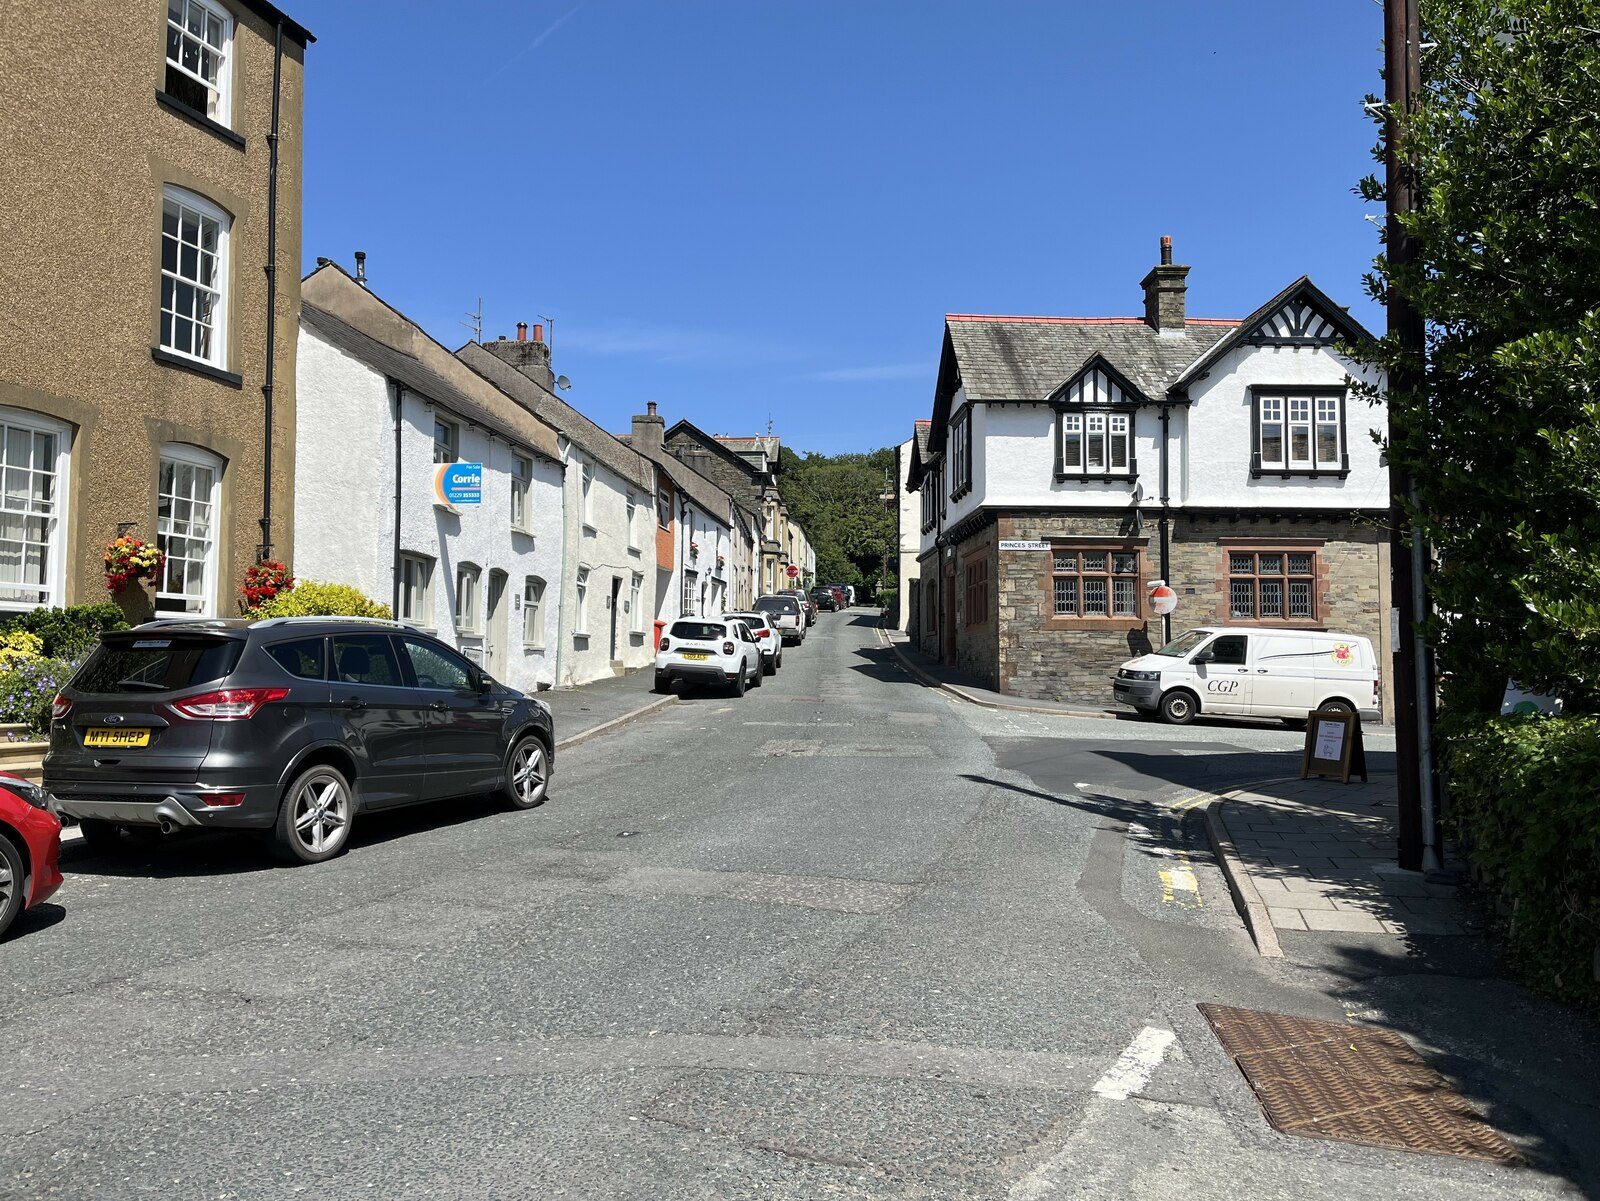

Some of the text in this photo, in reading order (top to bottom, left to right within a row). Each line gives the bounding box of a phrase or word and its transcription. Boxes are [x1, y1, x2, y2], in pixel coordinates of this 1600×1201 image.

[452, 473, 480, 483] Corrie
[1207, 680, 1238, 692] CGP
[112, 731, 145, 742] 5HEP
